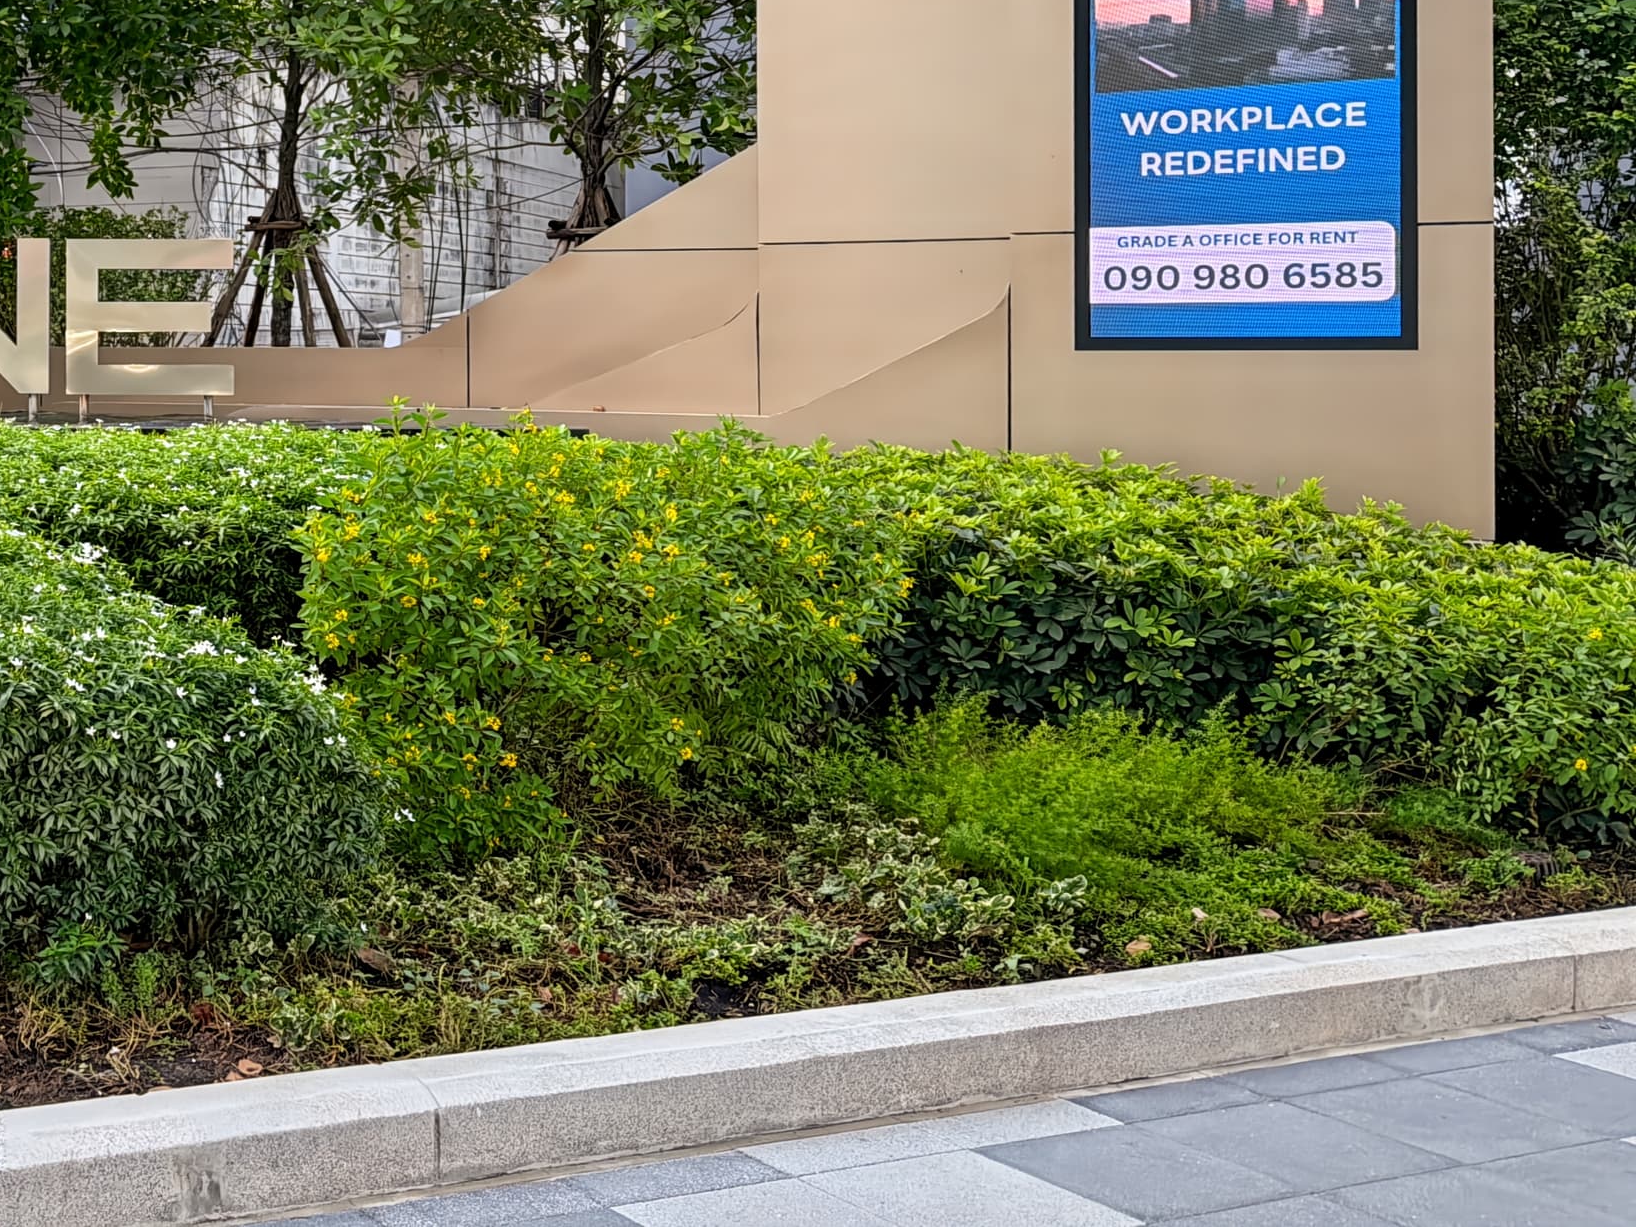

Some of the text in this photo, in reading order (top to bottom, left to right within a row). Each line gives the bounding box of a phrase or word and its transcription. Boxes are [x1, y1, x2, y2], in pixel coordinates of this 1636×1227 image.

[1121, 101, 1367, 136] WORKPLACE
[1140, 145, 1346, 177] REDEFINED
[1117, 231, 1359, 248] GRADE A OFFICE FOR RENT
[1103, 261, 1384, 291] 090 980 6585
